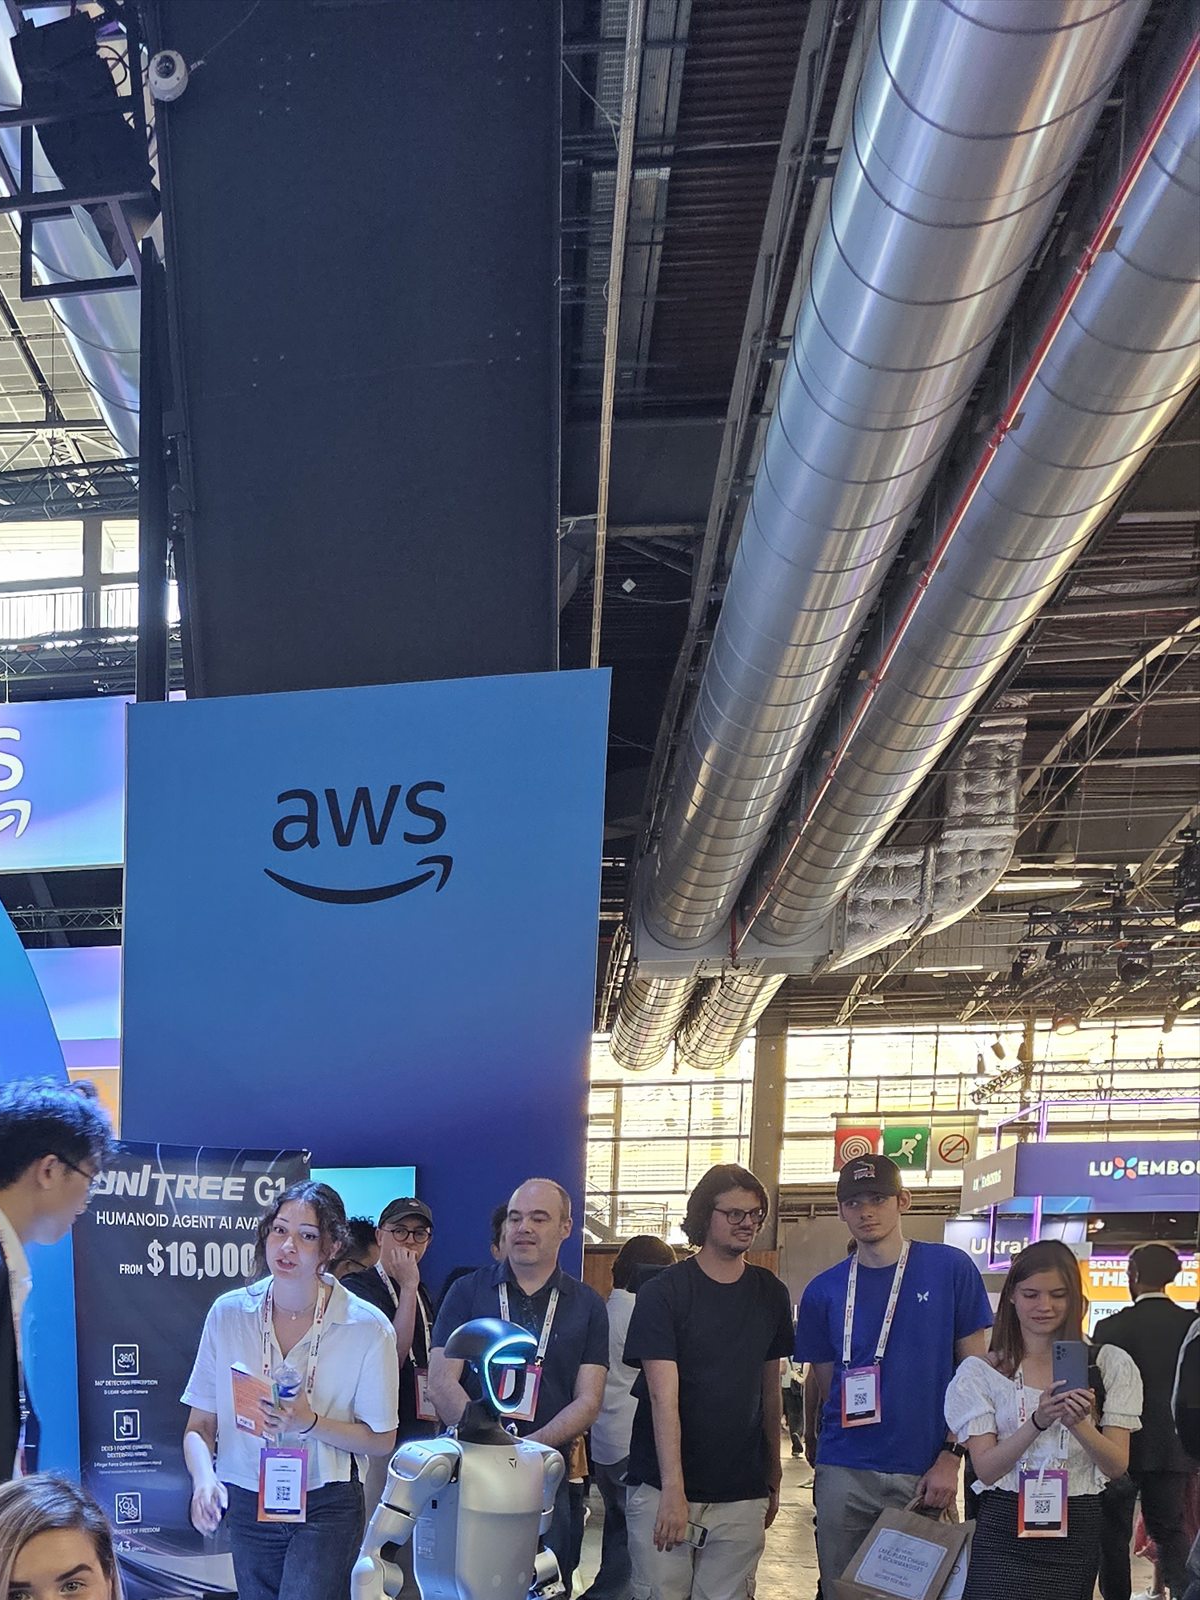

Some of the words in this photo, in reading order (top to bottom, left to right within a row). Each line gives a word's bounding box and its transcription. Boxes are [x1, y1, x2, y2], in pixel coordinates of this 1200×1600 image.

[272, 780, 447, 852] aws
[1089, 1156, 1200, 1180] LUXEMBO
[95, 1164, 247, 1206] UNITREE
[96, 1211, 169, 1228] HUMANOID
[172, 1214, 214, 1229] AGENT
[219, 1217, 232, 1230] AI
[119, 1264, 143, 1275] FROM
